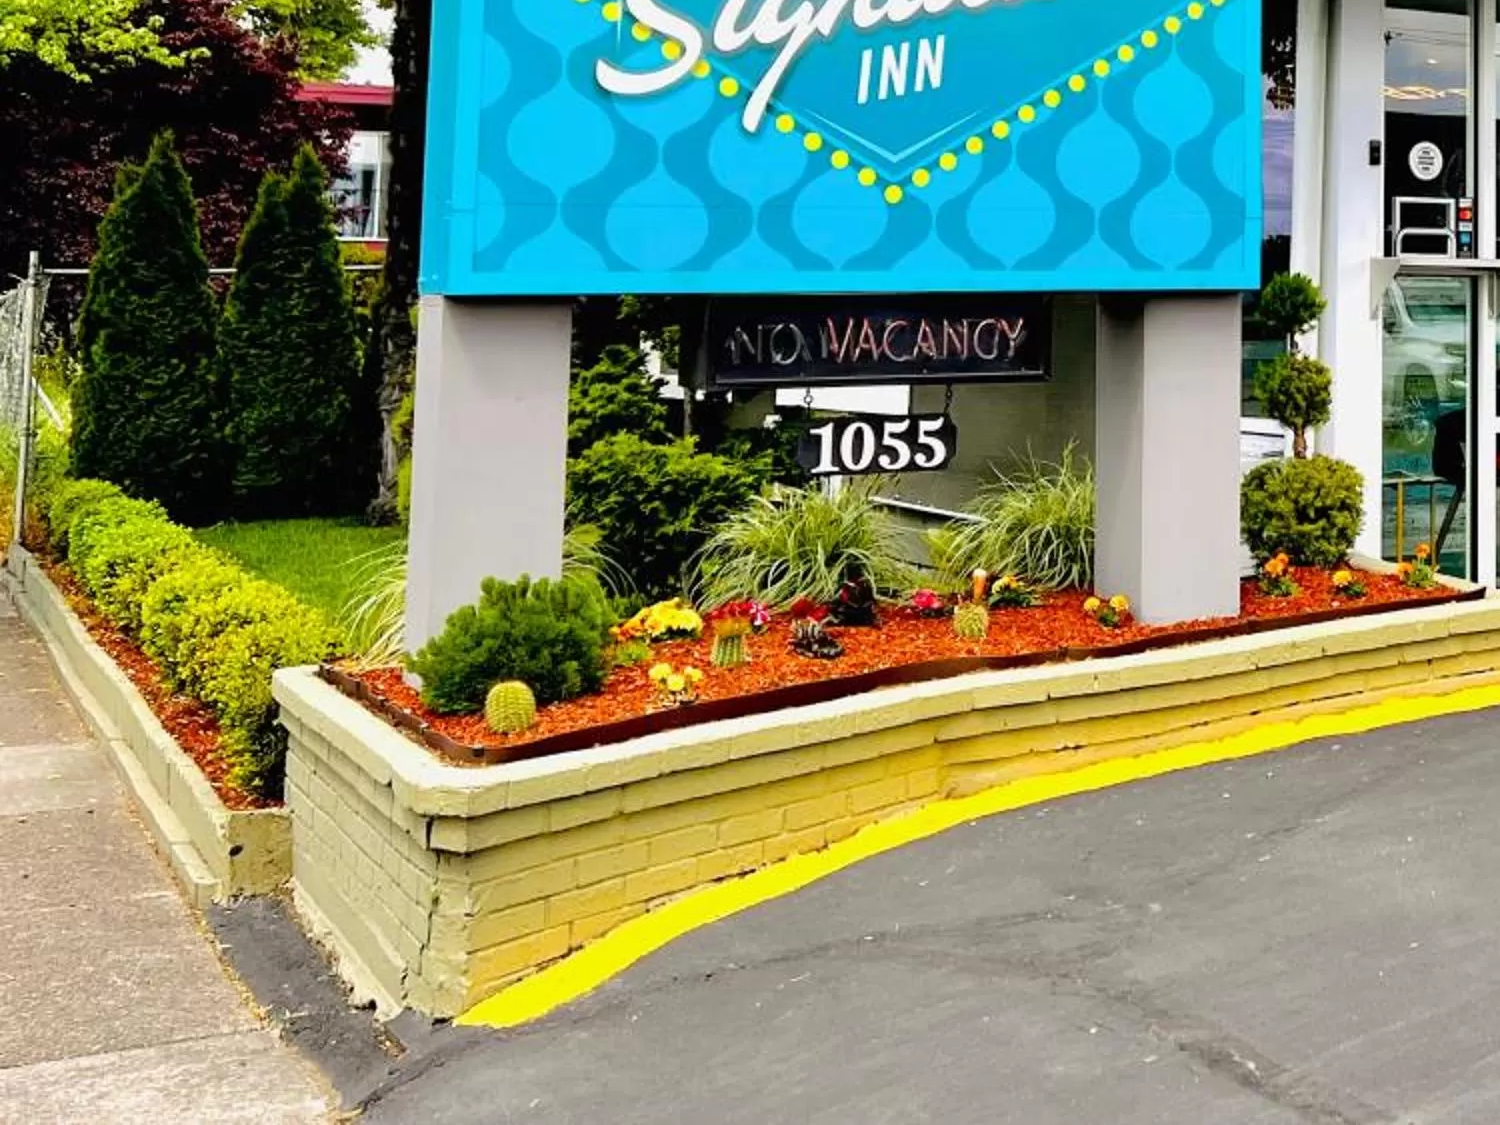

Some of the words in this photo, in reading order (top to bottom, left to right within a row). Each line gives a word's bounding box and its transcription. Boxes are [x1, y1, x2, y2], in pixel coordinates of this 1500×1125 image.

[857, 35, 945, 104] INN
[726, 323, 805, 365] NO
[827, 317, 1024, 364] VACANCY
[810, 416, 948, 474] 1055
